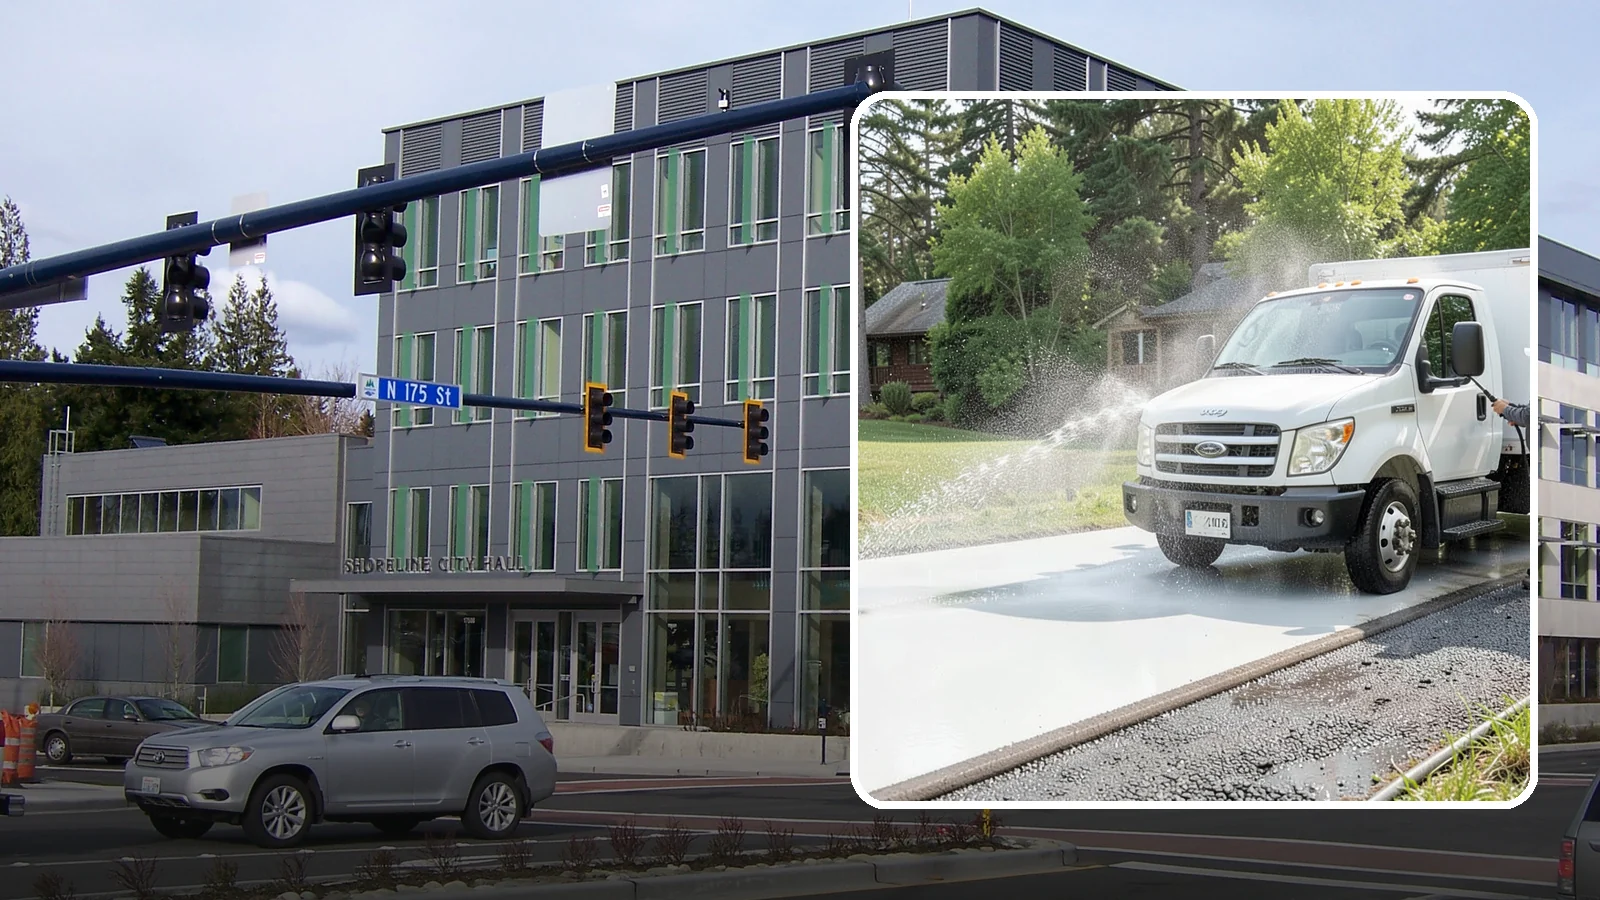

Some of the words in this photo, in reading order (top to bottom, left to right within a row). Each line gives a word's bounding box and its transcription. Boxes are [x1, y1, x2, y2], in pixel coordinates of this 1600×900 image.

[387, 380, 396, 400] N
[405, 382, 427, 403] 175
[436, 386, 451, 406] St
[344, 556, 432, 573] SHORELINE
[438, 556, 475, 572] CITY
[484, 555, 525, 571] HALL
